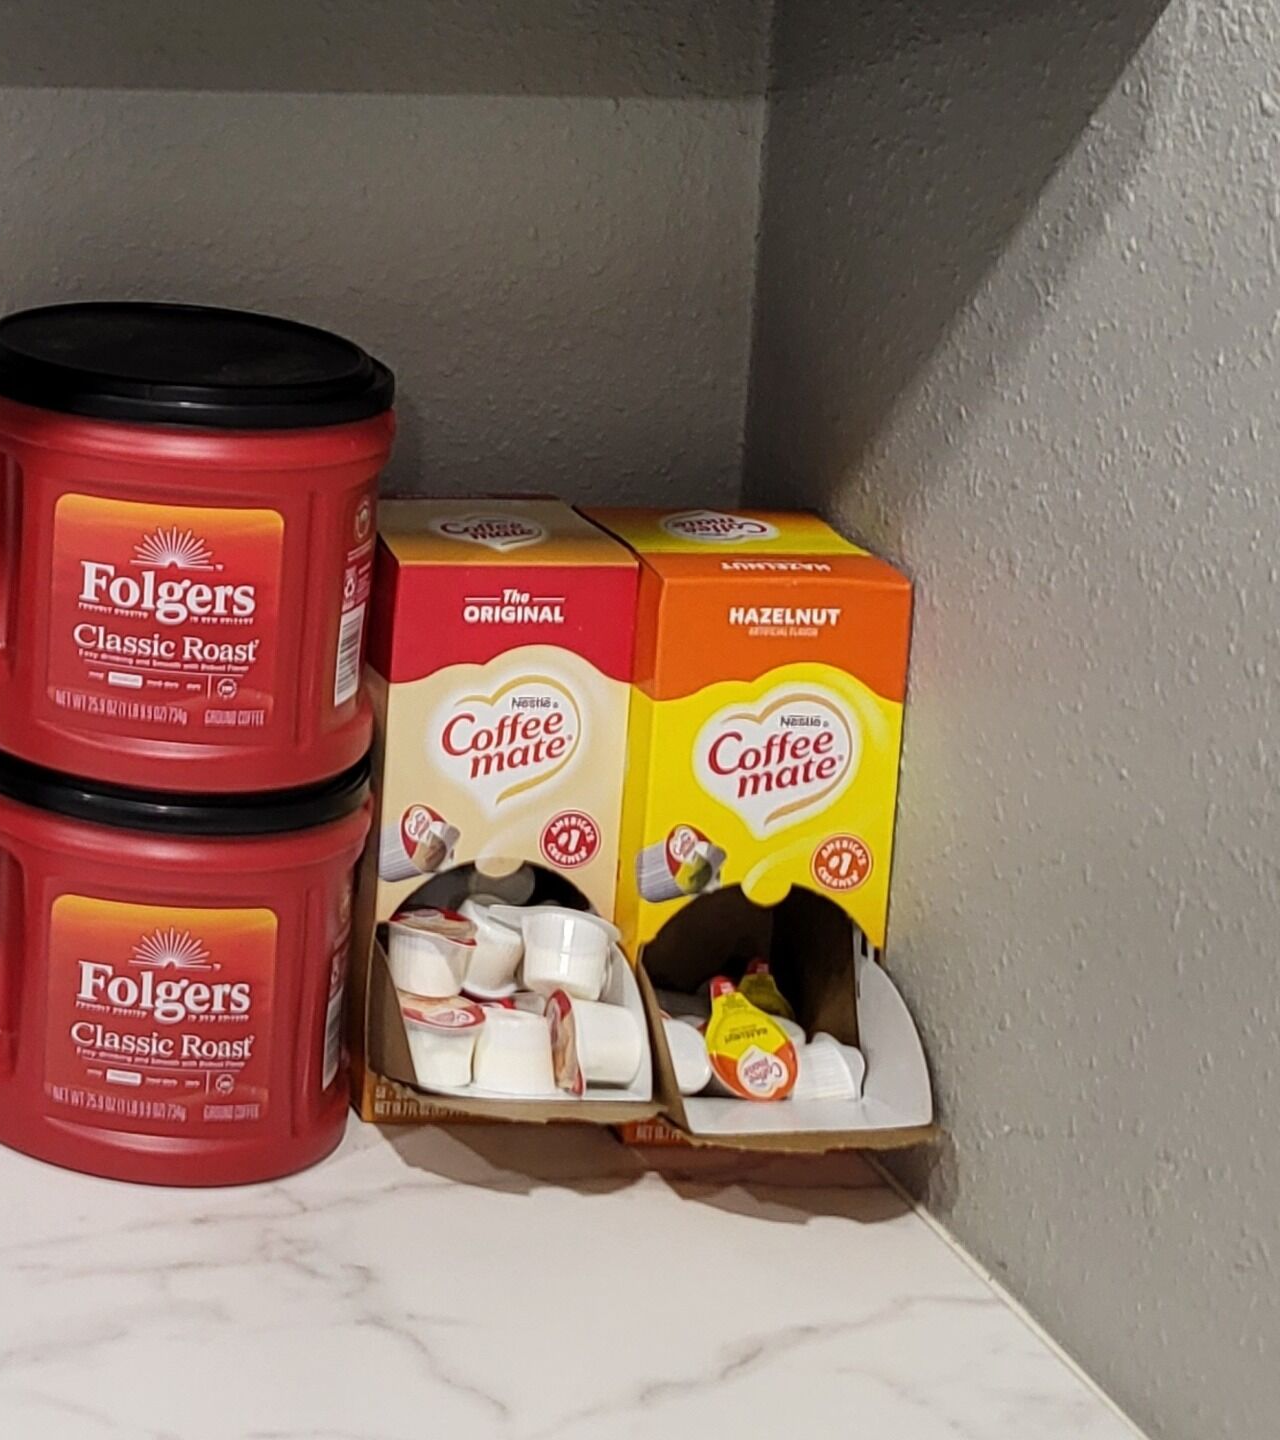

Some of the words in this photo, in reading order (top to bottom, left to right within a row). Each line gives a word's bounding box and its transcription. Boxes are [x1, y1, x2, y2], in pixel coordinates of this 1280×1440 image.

[78, 560, 256, 626] Folgers
[502, 589, 530, 604] The
[463, 605, 565, 624] ORIGINAL
[729, 607, 842, 626] HAZELNUT
[73, 623, 176, 658] Classic
[183, 636, 257, 663] Roast
[442, 712, 564, 756] Coffee
[708, 731, 834, 775] Coffee
[470, 736, 566, 779] mate
[737, 757, 837, 799] mate
[76, 960, 251, 1025] Folgers
[70, 1022, 174, 1057] Classic
[181, 1034, 253, 1060] Roast
